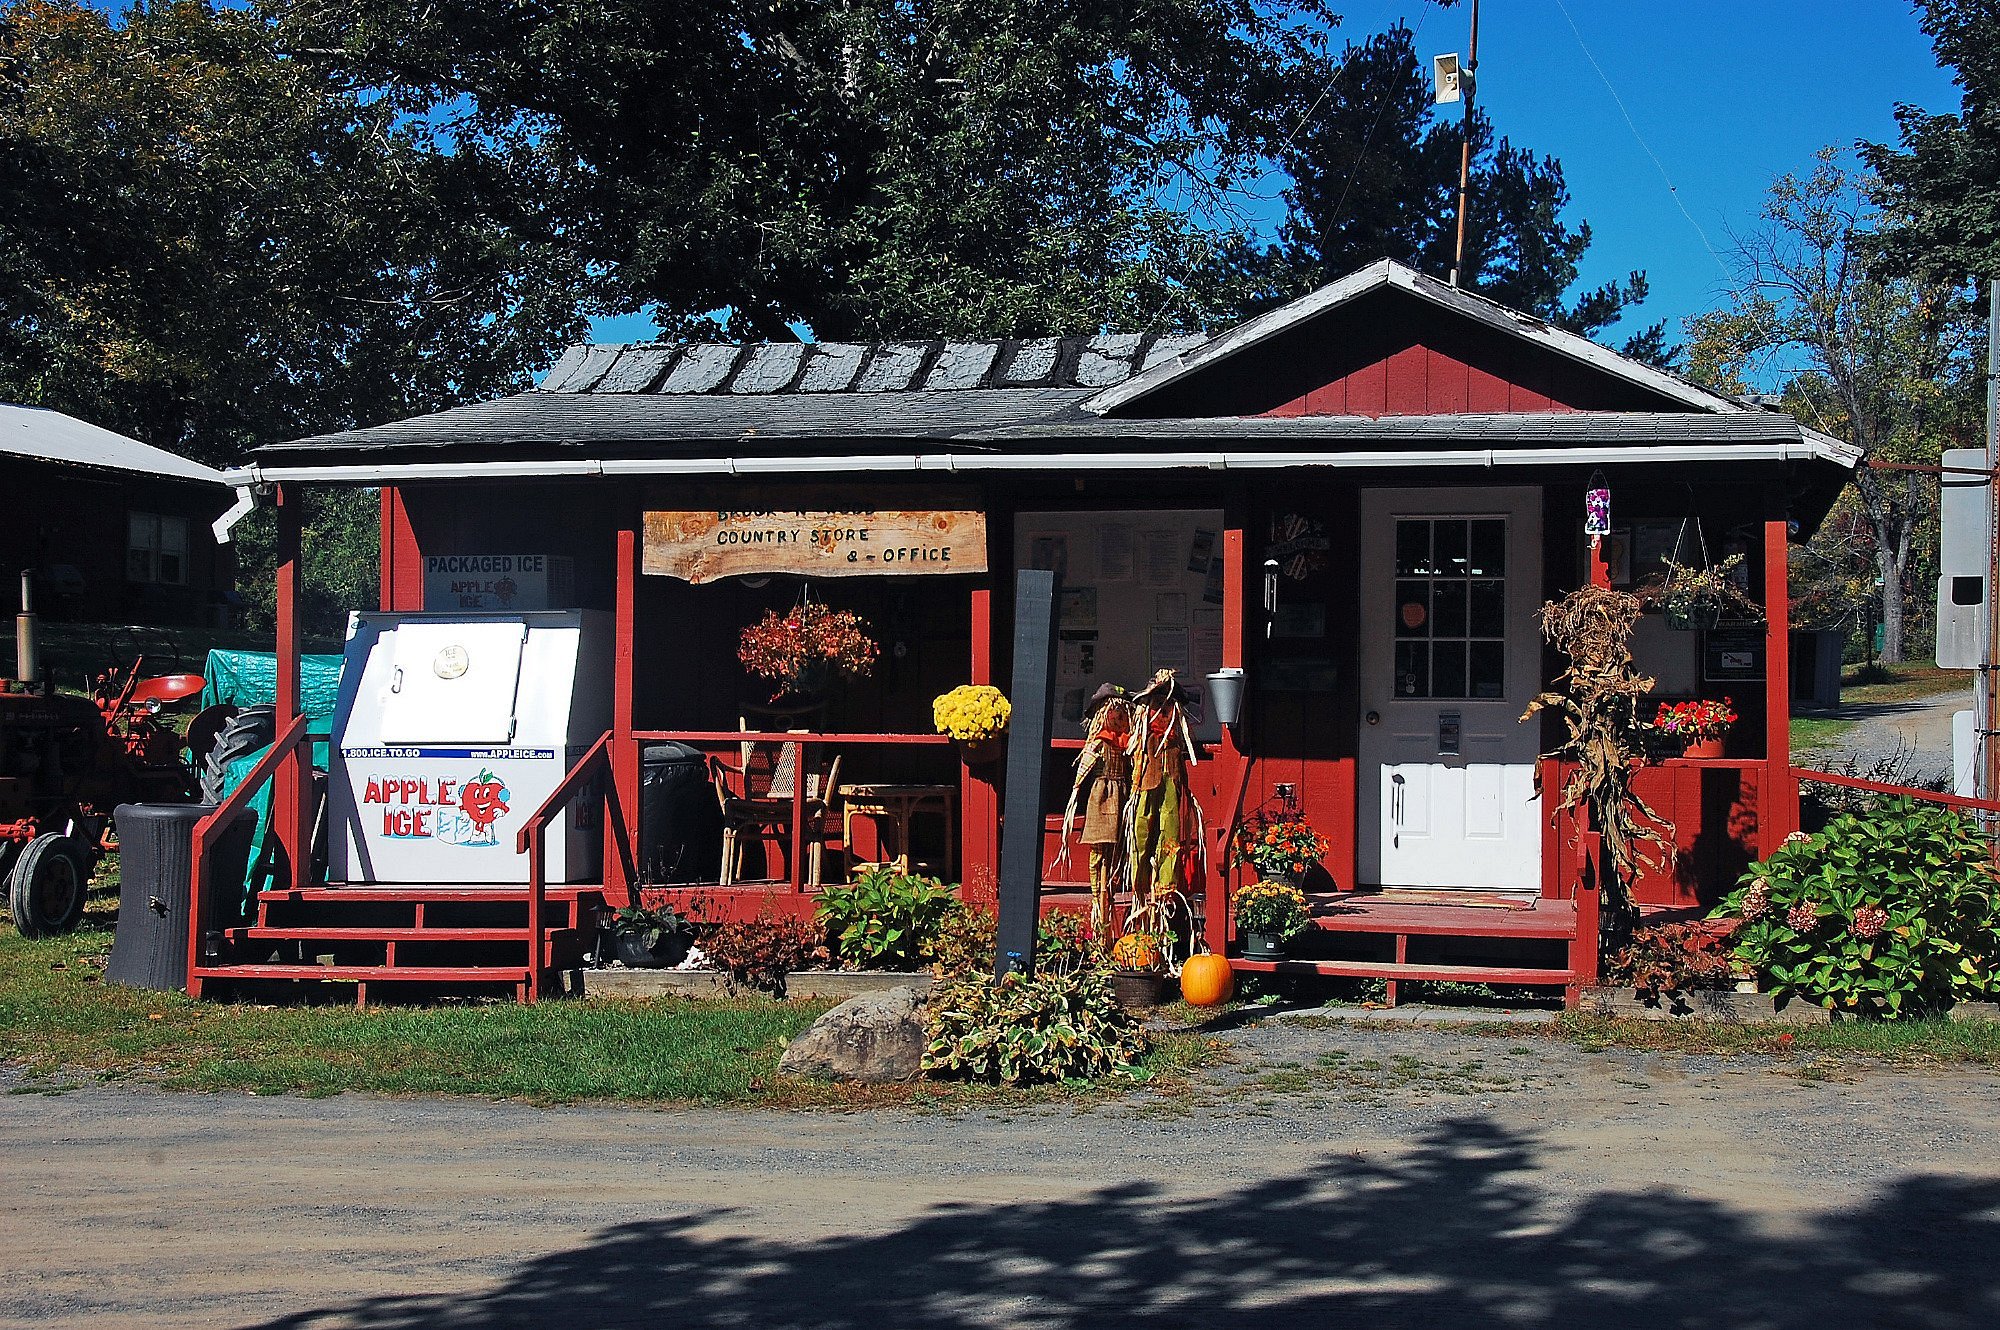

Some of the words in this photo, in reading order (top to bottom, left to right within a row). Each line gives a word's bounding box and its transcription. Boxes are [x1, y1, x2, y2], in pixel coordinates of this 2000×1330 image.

[716, 529, 800, 545] COUNTRY
[809, 528, 869, 543] STORE
[428, 556, 512, 573] PACKAGED
[517, 556, 543, 572] ICE
[846, 550, 858, 562] &
[450, 580, 495, 594] APPLE
[458, 594, 484, 608] ICE
[363, 774, 457, 805] APPLE
[383, 805, 433, 837] ICE
